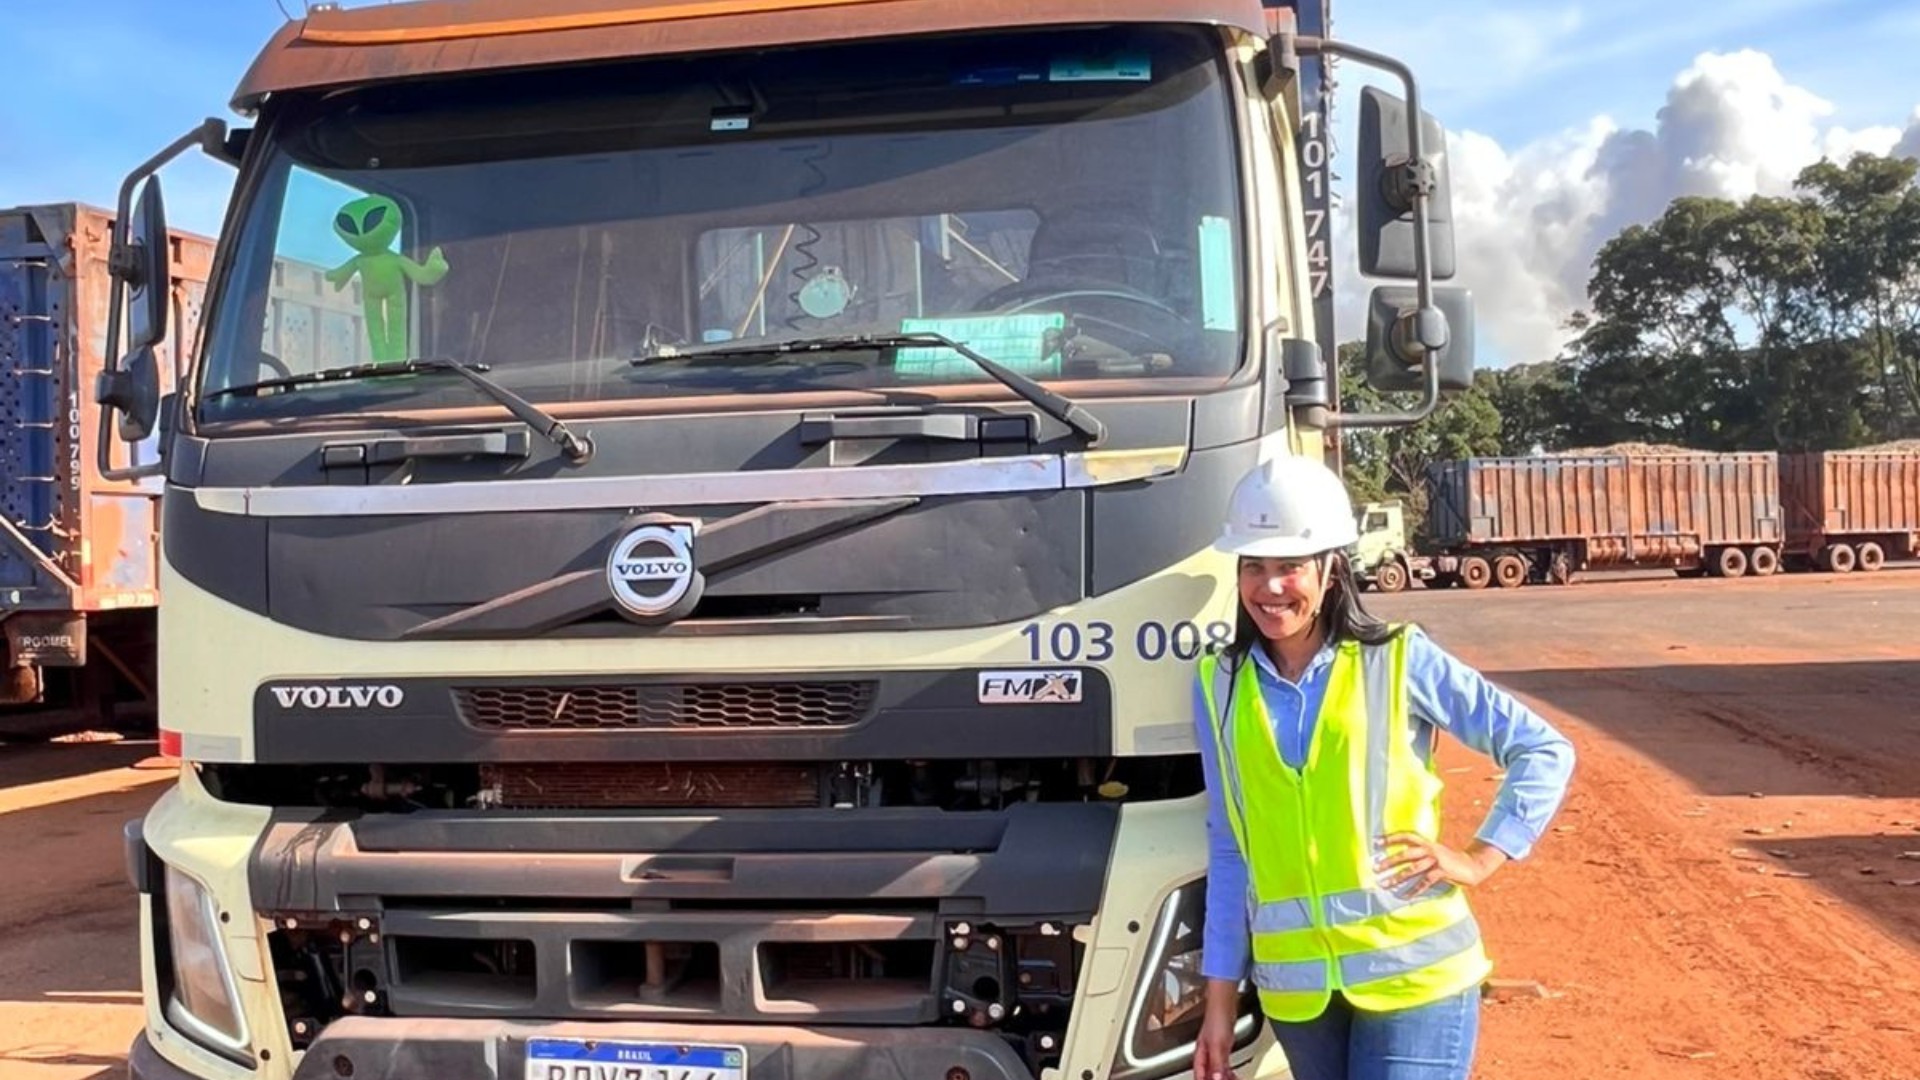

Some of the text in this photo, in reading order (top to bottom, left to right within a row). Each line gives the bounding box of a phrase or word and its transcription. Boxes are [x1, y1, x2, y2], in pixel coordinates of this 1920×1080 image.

[1302, 111, 1329, 298] 101 747
[68, 392, 80, 439] 100
[615, 562, 687, 575] VOLVO
[17, 635, 74, 648] RGOMEL
[1020, 620, 1232, 662] 103 008
[270, 684, 404, 709] VOLVO
[617, 1049, 653, 1062] BRASIL
